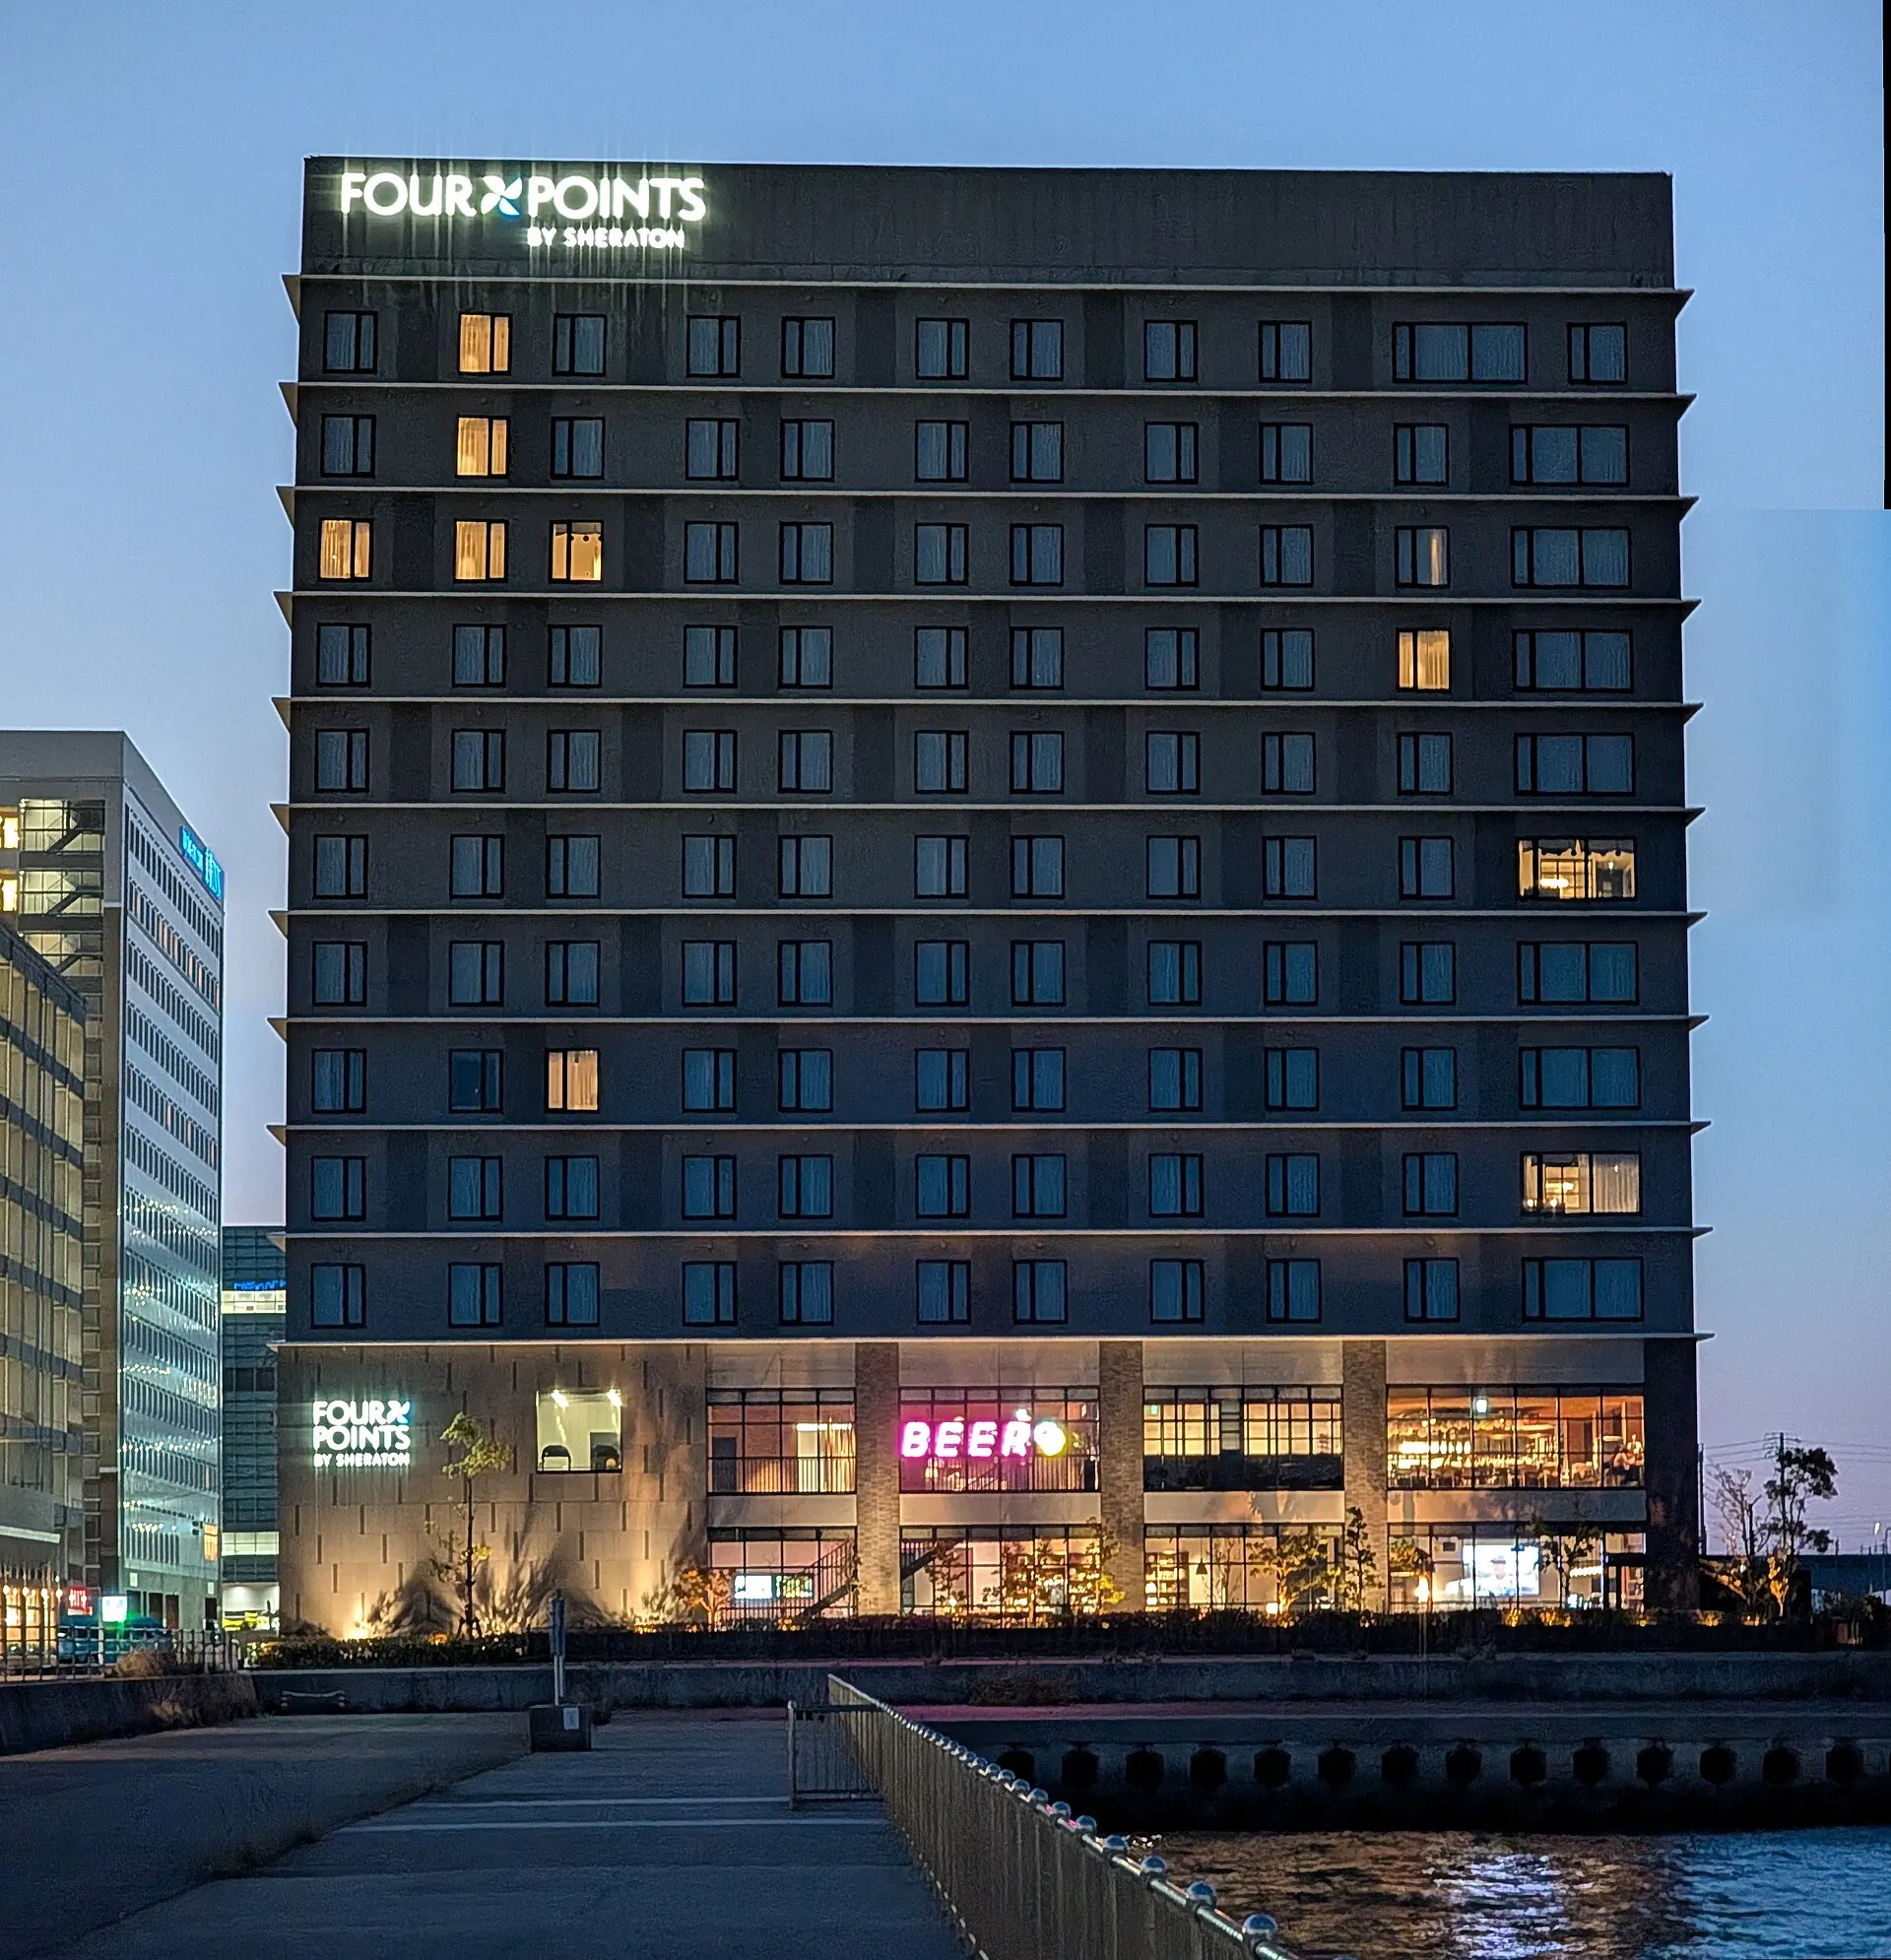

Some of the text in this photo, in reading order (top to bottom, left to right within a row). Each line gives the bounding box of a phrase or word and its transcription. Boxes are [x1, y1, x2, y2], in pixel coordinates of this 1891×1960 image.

[341, 172, 706, 222] FOUR POINTS
[527, 227, 685, 248] BY SHERATON
[313, 1400, 387, 1425] FOUR
[313, 1425, 411, 1450] POINTS
[901, 1421, 1030, 1457] BEER
[314, 1452, 410, 1467] BY SHERATON
